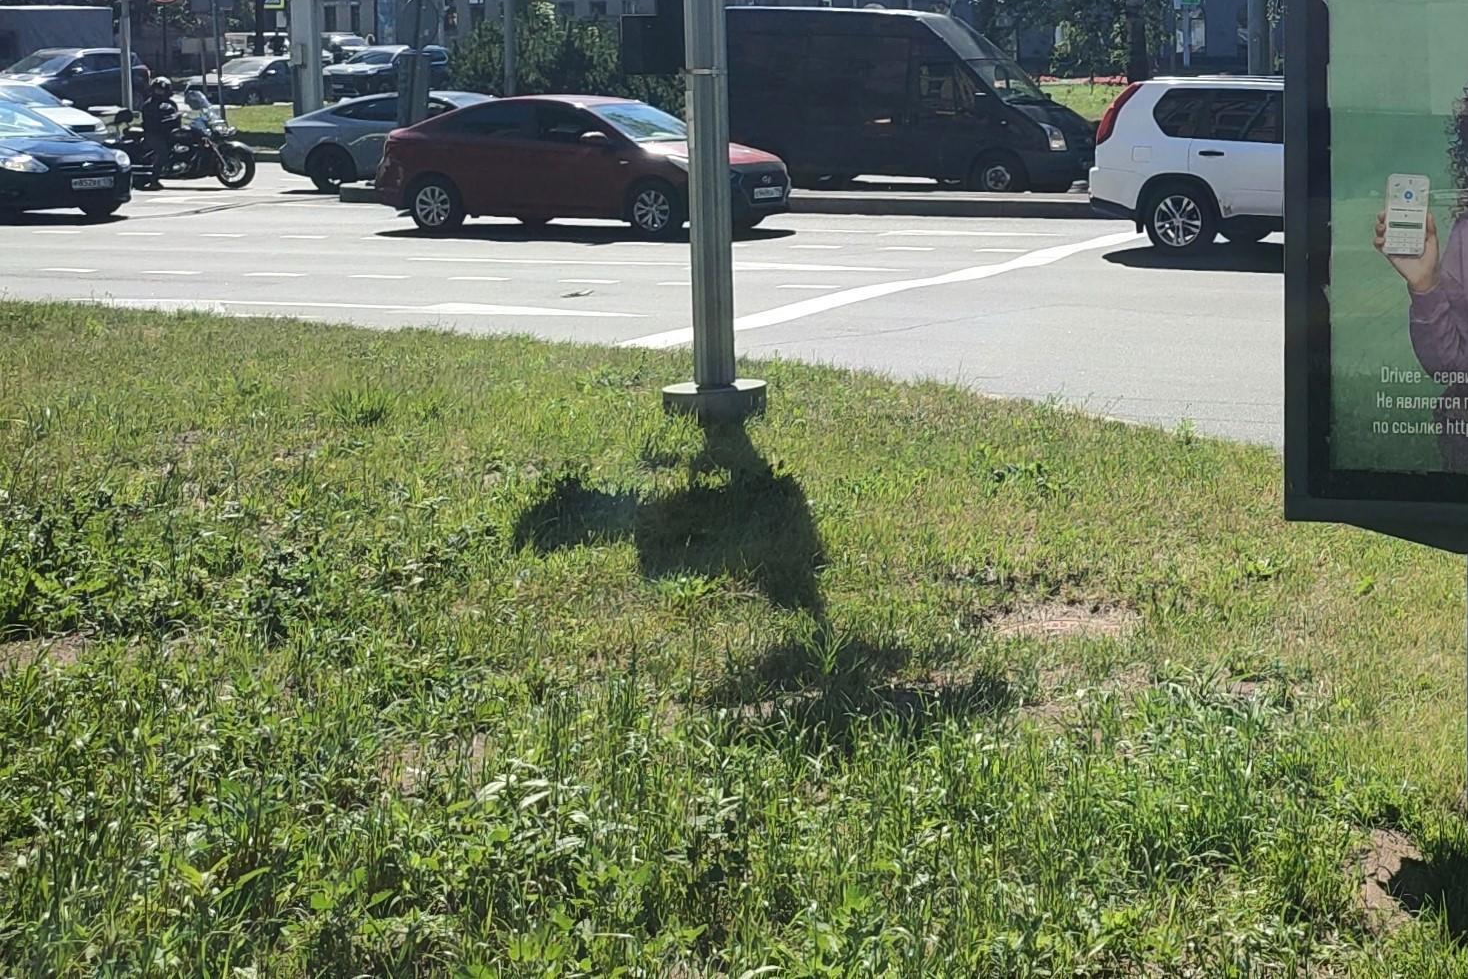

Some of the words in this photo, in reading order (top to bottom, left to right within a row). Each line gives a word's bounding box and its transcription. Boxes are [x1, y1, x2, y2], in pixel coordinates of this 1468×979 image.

[1381, 366, 1421, 383] Drivee
[1376, 391, 1393, 408] Не
[1396, 396, 1461, 409] является
[1373, 421, 1389, 434] по
[1392, 421, 1443, 435] ссылке
